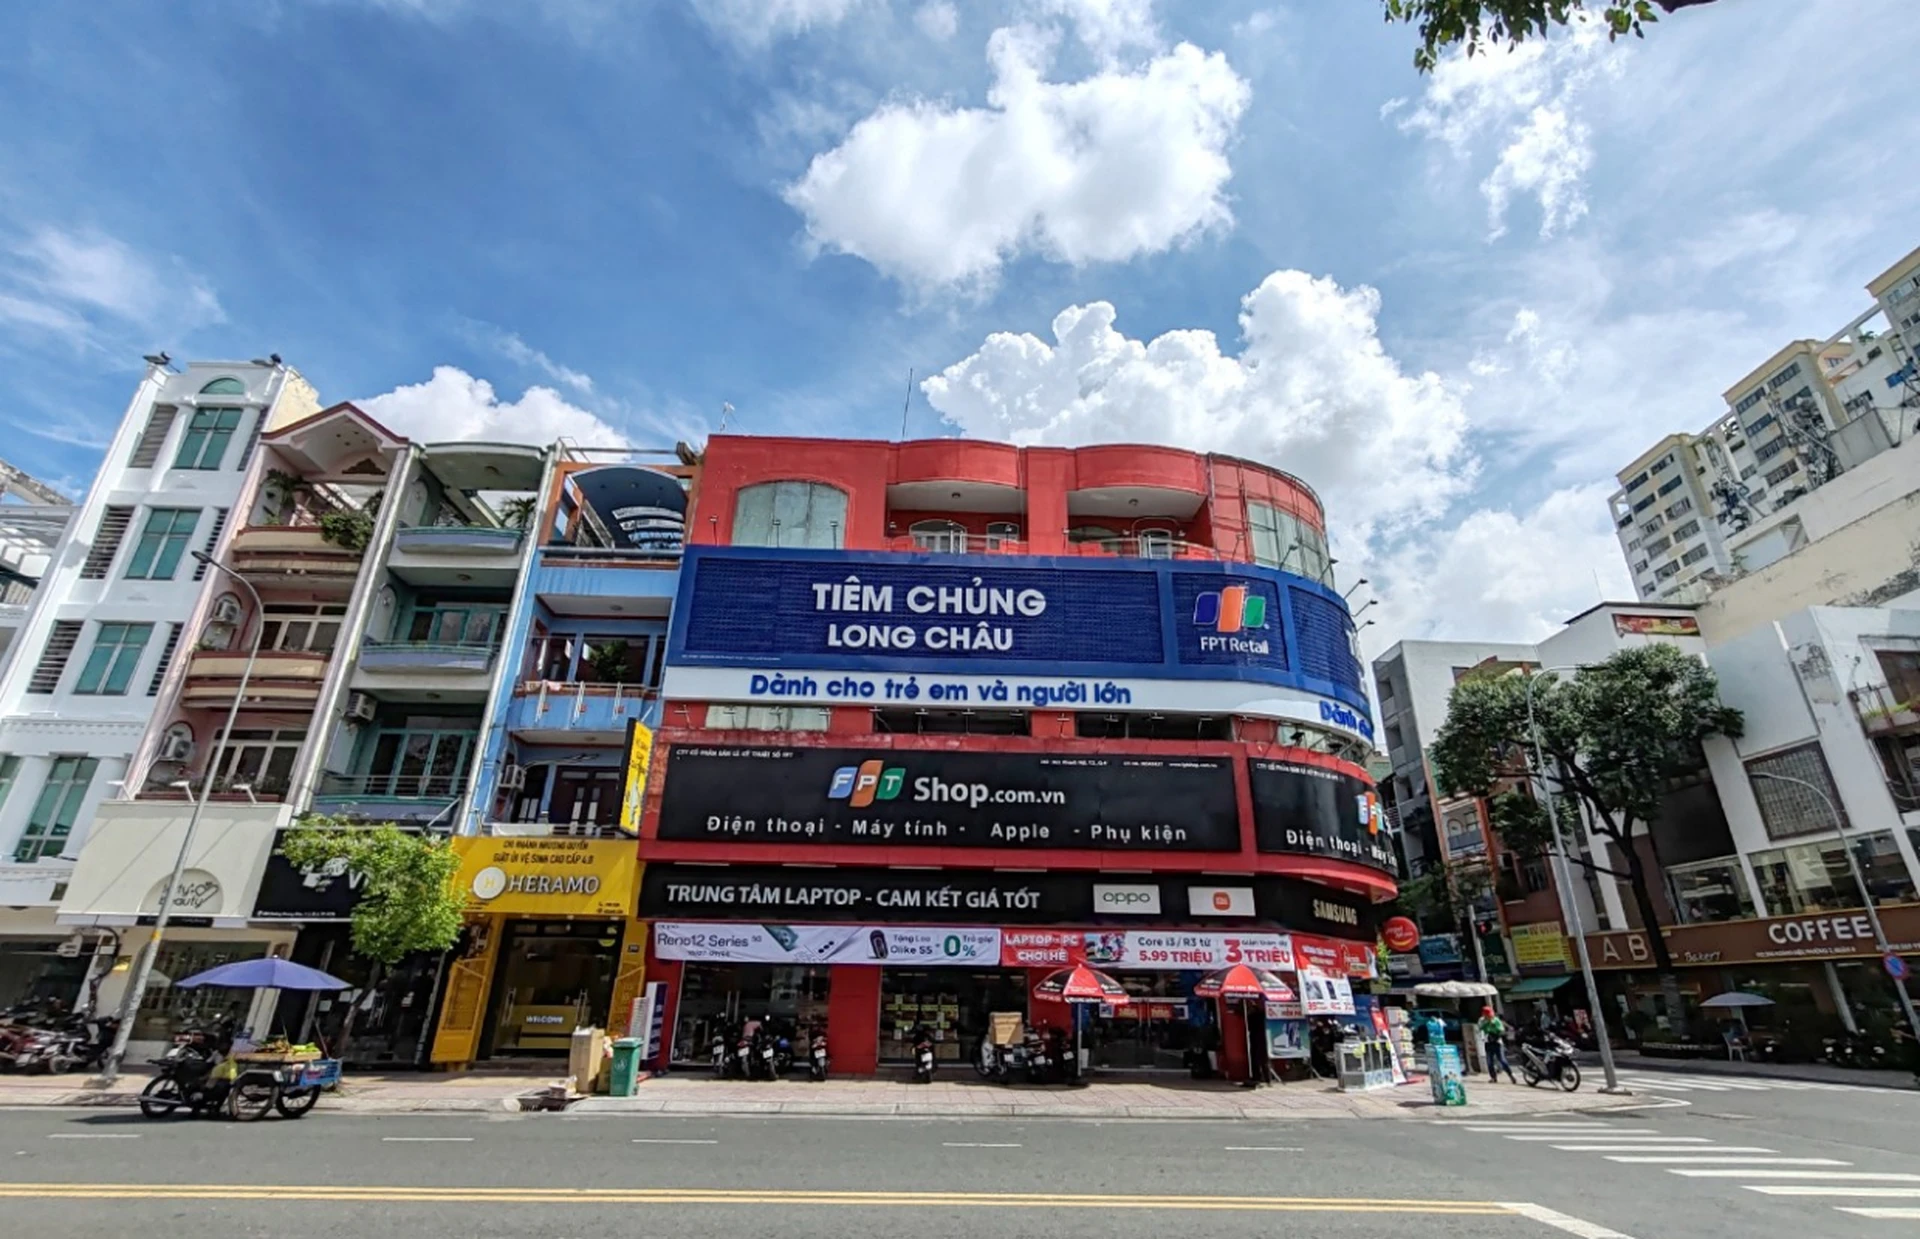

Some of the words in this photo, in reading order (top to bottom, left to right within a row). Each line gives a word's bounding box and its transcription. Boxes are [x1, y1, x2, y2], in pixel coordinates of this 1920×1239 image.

[812, 575, 893, 613] TIÊM
[907, 576, 1047, 616] CHỦNG
[828, 624, 916, 649] LONG
[924, 621, 1013, 650] CHÂU
[1200, 636, 1227, 651] FPT
[1232, 638, 1269, 655] Retail
[750, 673, 817, 697] Dành
[827, 676, 875, 698] cho
[885, 677, 920, 700] trẻ
[929, 683, 968, 701] em
[978, 680, 1008, 701] và
[1017, 681, 1086, 706] người
[1094, 682, 1131, 704] lớn
[1319, 700, 1357, 730] Dành
[914, 777, 1065, 808] Shop.com.vn
[707, 816, 755, 835] Điện
[767, 818, 824, 837] thoại
[852, 819, 894, 838] Máy
[905, 819, 947, 835] tính
[990, 823, 1050, 841] Apple
[1090, 824, 1131, 844] Phụ
[1141, 825, 1187, 844] kiện
[1286, 829, 1325, 851] Điện
[1329, 836, 1362, 857] thoại
[549, 854, 565, 864] CAO
[507, 875, 600, 895] HERAMO
[667, 884, 735, 903] TRUNG
[739, 883, 781, 905] TÂM
[785, 886, 861, 906] LAPTOP
[877, 889, 922, 907] CAM
[926, 886, 962, 908] KẾT
[966, 888, 1000, 909] GIÁ
[1003, 886, 1041, 909] TỐT
[1313, 898, 1358, 926] SAMSUNG
[657, 934, 705, 947] Reno12
[708, 935, 749, 947] Series
[1004, 934, 1052, 946] LAPTOP
[1061, 935, 1079, 946] PC
[1138, 936, 1163, 946] Core
[1199, 938, 1212, 947] từ
[1768, 916, 1874, 944] COFFEE
[944, 935, 961, 957] 0
[1139, 950, 1169, 962] 5.99
[1170, 947, 1213, 966] TRIỆU
[1224, 939, 1243, 963] 3
[1244, 947, 1290, 965] TRIỆU
[1603, 937, 1621, 962] A
[1627, 934, 1649, 961] B
